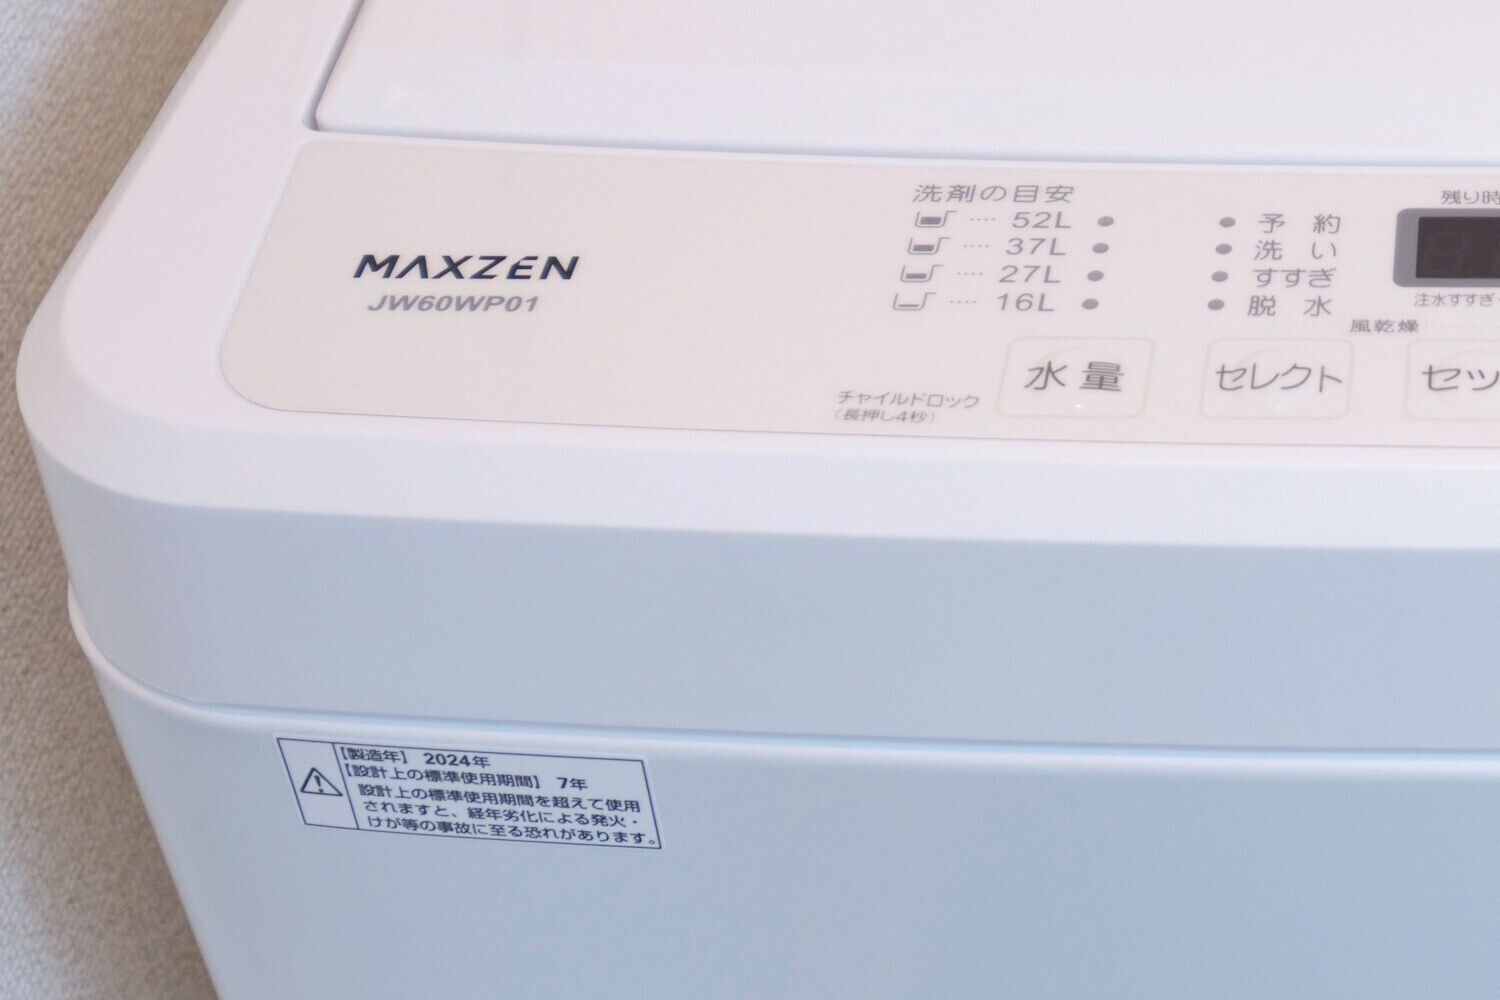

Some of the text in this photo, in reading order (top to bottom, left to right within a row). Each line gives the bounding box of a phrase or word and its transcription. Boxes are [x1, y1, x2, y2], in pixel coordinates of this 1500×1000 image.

[912, 183, 1075, 203] 洗剤の目安
[1011, 210, 1072, 229] 52L
[1258, 213, 1342, 235] 予約
[1005, 237, 1067, 257] 37L
[1253, 239, 1337, 261] 洗い
[353, 254, 580, 281] MAXZEN
[998, 264, 1060, 284] 27L
[1252, 267, 1337, 289] すすぎ
[367, 294, 539, 313] JW60WP01
[997, 292, 1055, 313] 16L
[1246, 294, 1332, 318] 脱水
[1414, 293, 1494, 308] 注水すすぎ
[1349, 318, 1420, 334] 風乾燥
[1023, 360, 1124, 393] 水量
[1215, 362, 1344, 394] セレクト
[837, 390, 980, 409] チャイルドロック
[421, 752, 491, 769] 2024年
[555, 776, 588, 791] 7年
[356, 783, 642, 814] 設計上の標準使用期間を超えて使用
